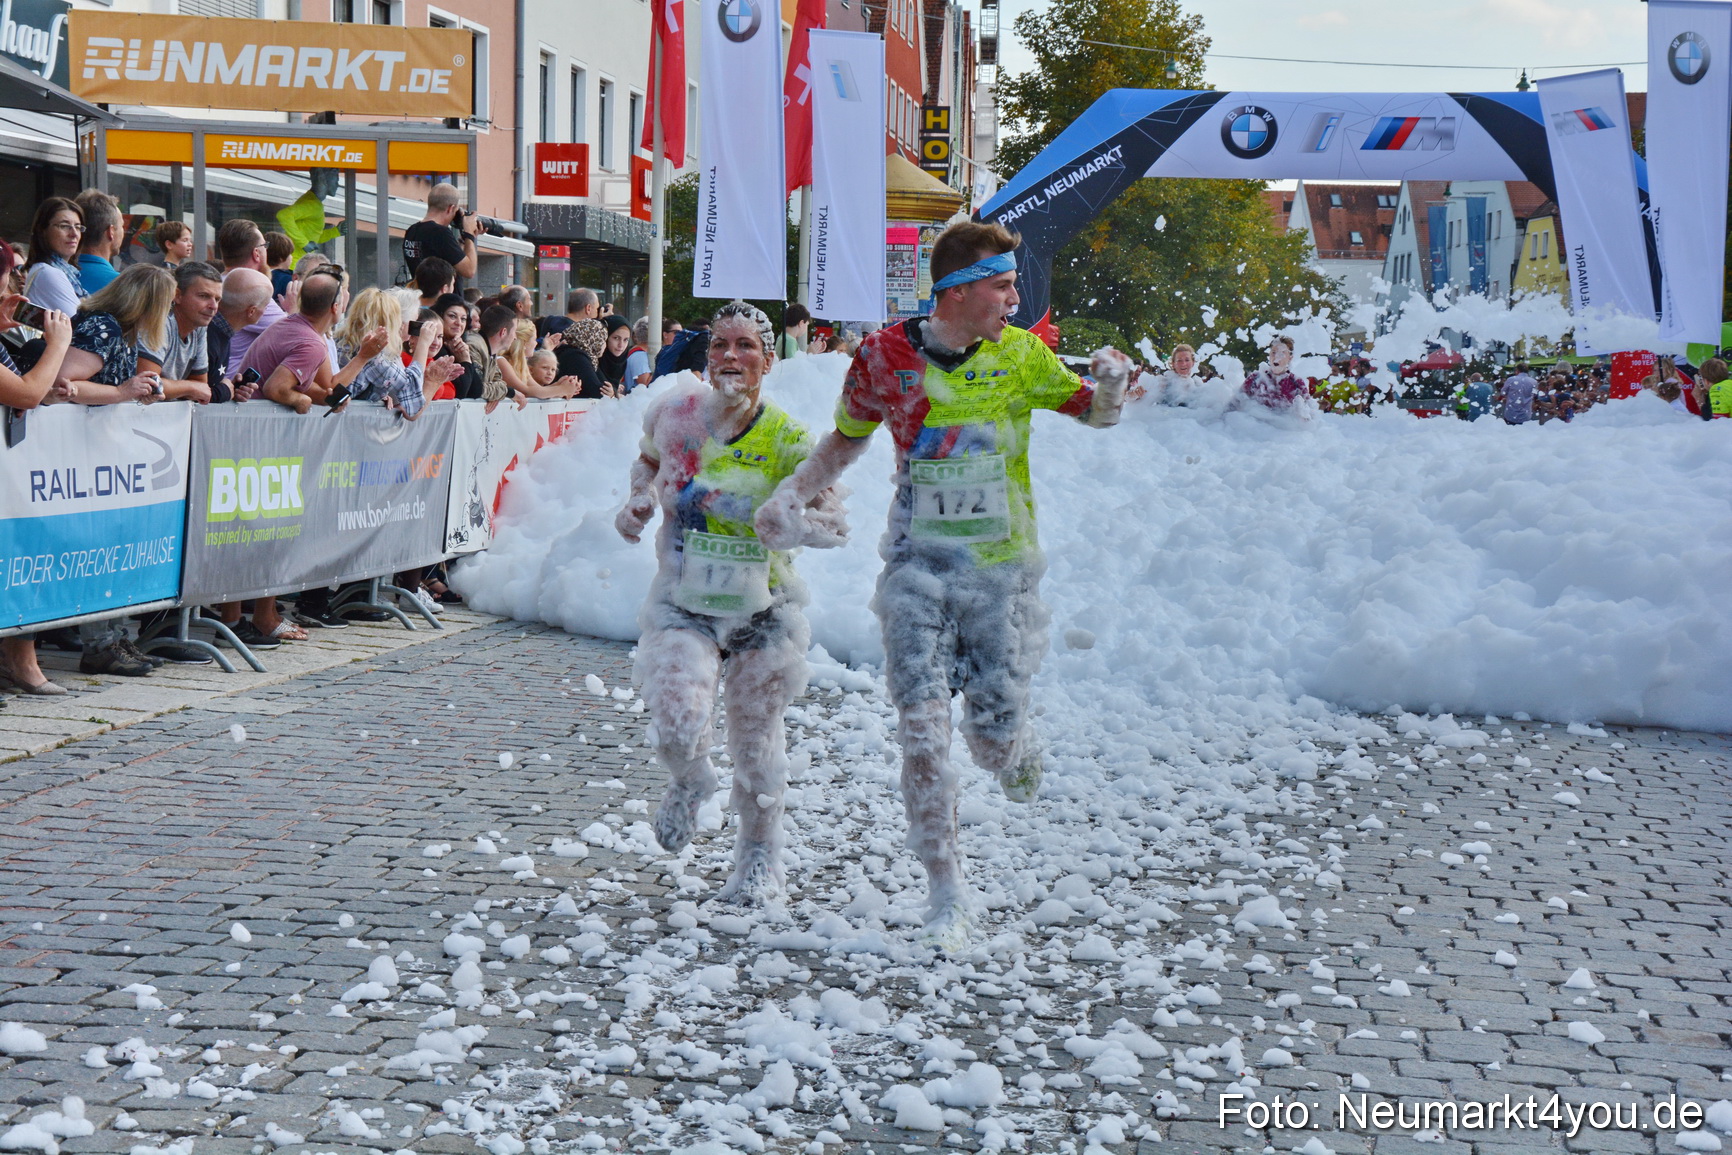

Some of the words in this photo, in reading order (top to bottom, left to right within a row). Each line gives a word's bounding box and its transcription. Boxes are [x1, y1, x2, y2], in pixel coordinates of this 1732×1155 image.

[82, 37, 453, 95] RUNMARKT.DE
[221, 141, 363, 163] RUNMARKT.DE
[542, 161, 578, 174] WITT
[998, 194, 1046, 227] PARTL
[1043, 144, 1124, 200] NEUMARKT
[30, 463, 147, 502] RAIL.ONE
[318, 461, 357, 489] OFFICE
[209, 464, 303, 514] BOCK
[933, 489, 987, 515] 172
[205, 526, 241, 550] inspired
[241, 525, 253, 548] by
[253, 525, 275, 543] smart
[690, 535, 765, 558] BOCK
[5, 553, 55, 591] JEDER
[56, 545, 121, 581] STRECKE
[120, 535, 177, 571] ZUHAUSE
[703, 563, 754, 589] 17
